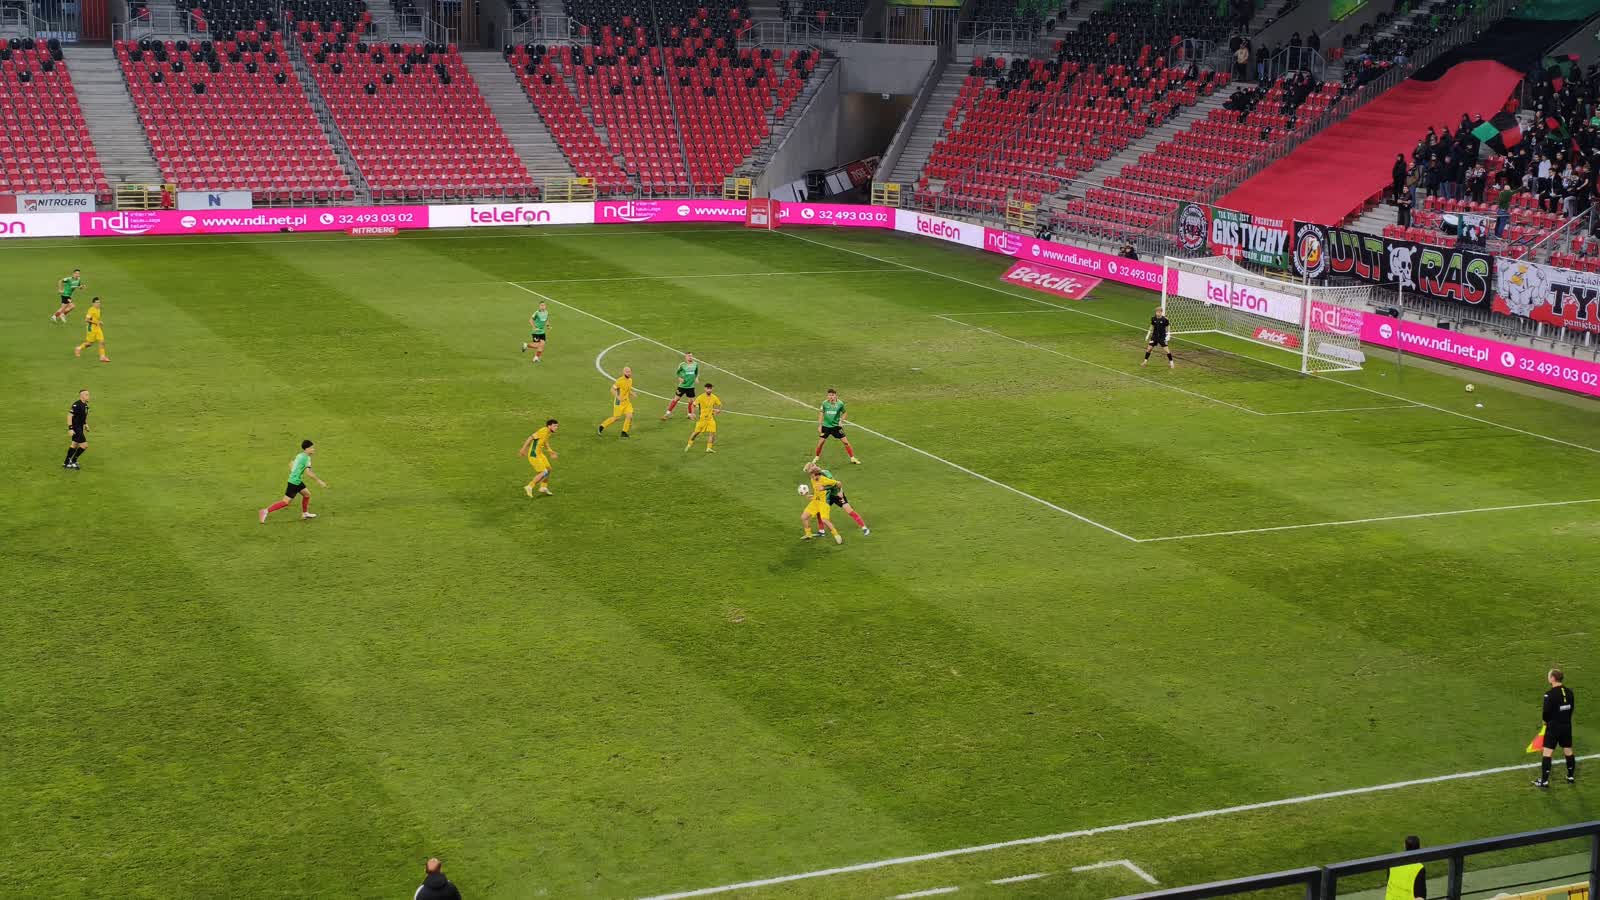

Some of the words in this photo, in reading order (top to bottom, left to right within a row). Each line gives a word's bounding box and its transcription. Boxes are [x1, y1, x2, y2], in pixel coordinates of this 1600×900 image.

[38, 198, 87, 207] NITROERG
[603, 201, 635, 218] ndi
[91, 211, 129, 230] ndi
[202, 214, 307, 226] www.ndi.net.pl
[338, 214, 354, 224] 32
[356, 213, 379, 223] 493
[381, 213, 397, 223] 03
[398, 212, 414, 222] 02
[470, 207, 550, 223] telefon
[818, 210, 833, 219] 32
[835, 211, 857, 220] 493
[858, 211, 873, 221] 03
[875, 212, 888, 222] 02
[352, 226, 395, 234] NITROERG
[916, 215, 961, 241] telefon
[1212, 218, 1239, 248] GKS
[1239, 223, 1288, 255] TYCHY
[988, 231, 1008, 249] ndi
[1042, 249, 1101, 271] www.ndi.net.pl
[1007, 266, 1084, 294] Betclic
[1119, 265, 1130, 277] 32
[1130, 268, 1145, 280] 493
[1146, 271, 1157, 283] 03
[1206, 280, 1268, 313] telefon
[1311, 305, 1340, 327] ndi
[1396, 330, 1489, 362] www.ndi.net.pl
[1519, 358, 1535, 372] 32
[1537, 362, 1560, 377] 493
[1562, 367, 1579, 382] 03
[1581, 371, 1598, 386] 02
